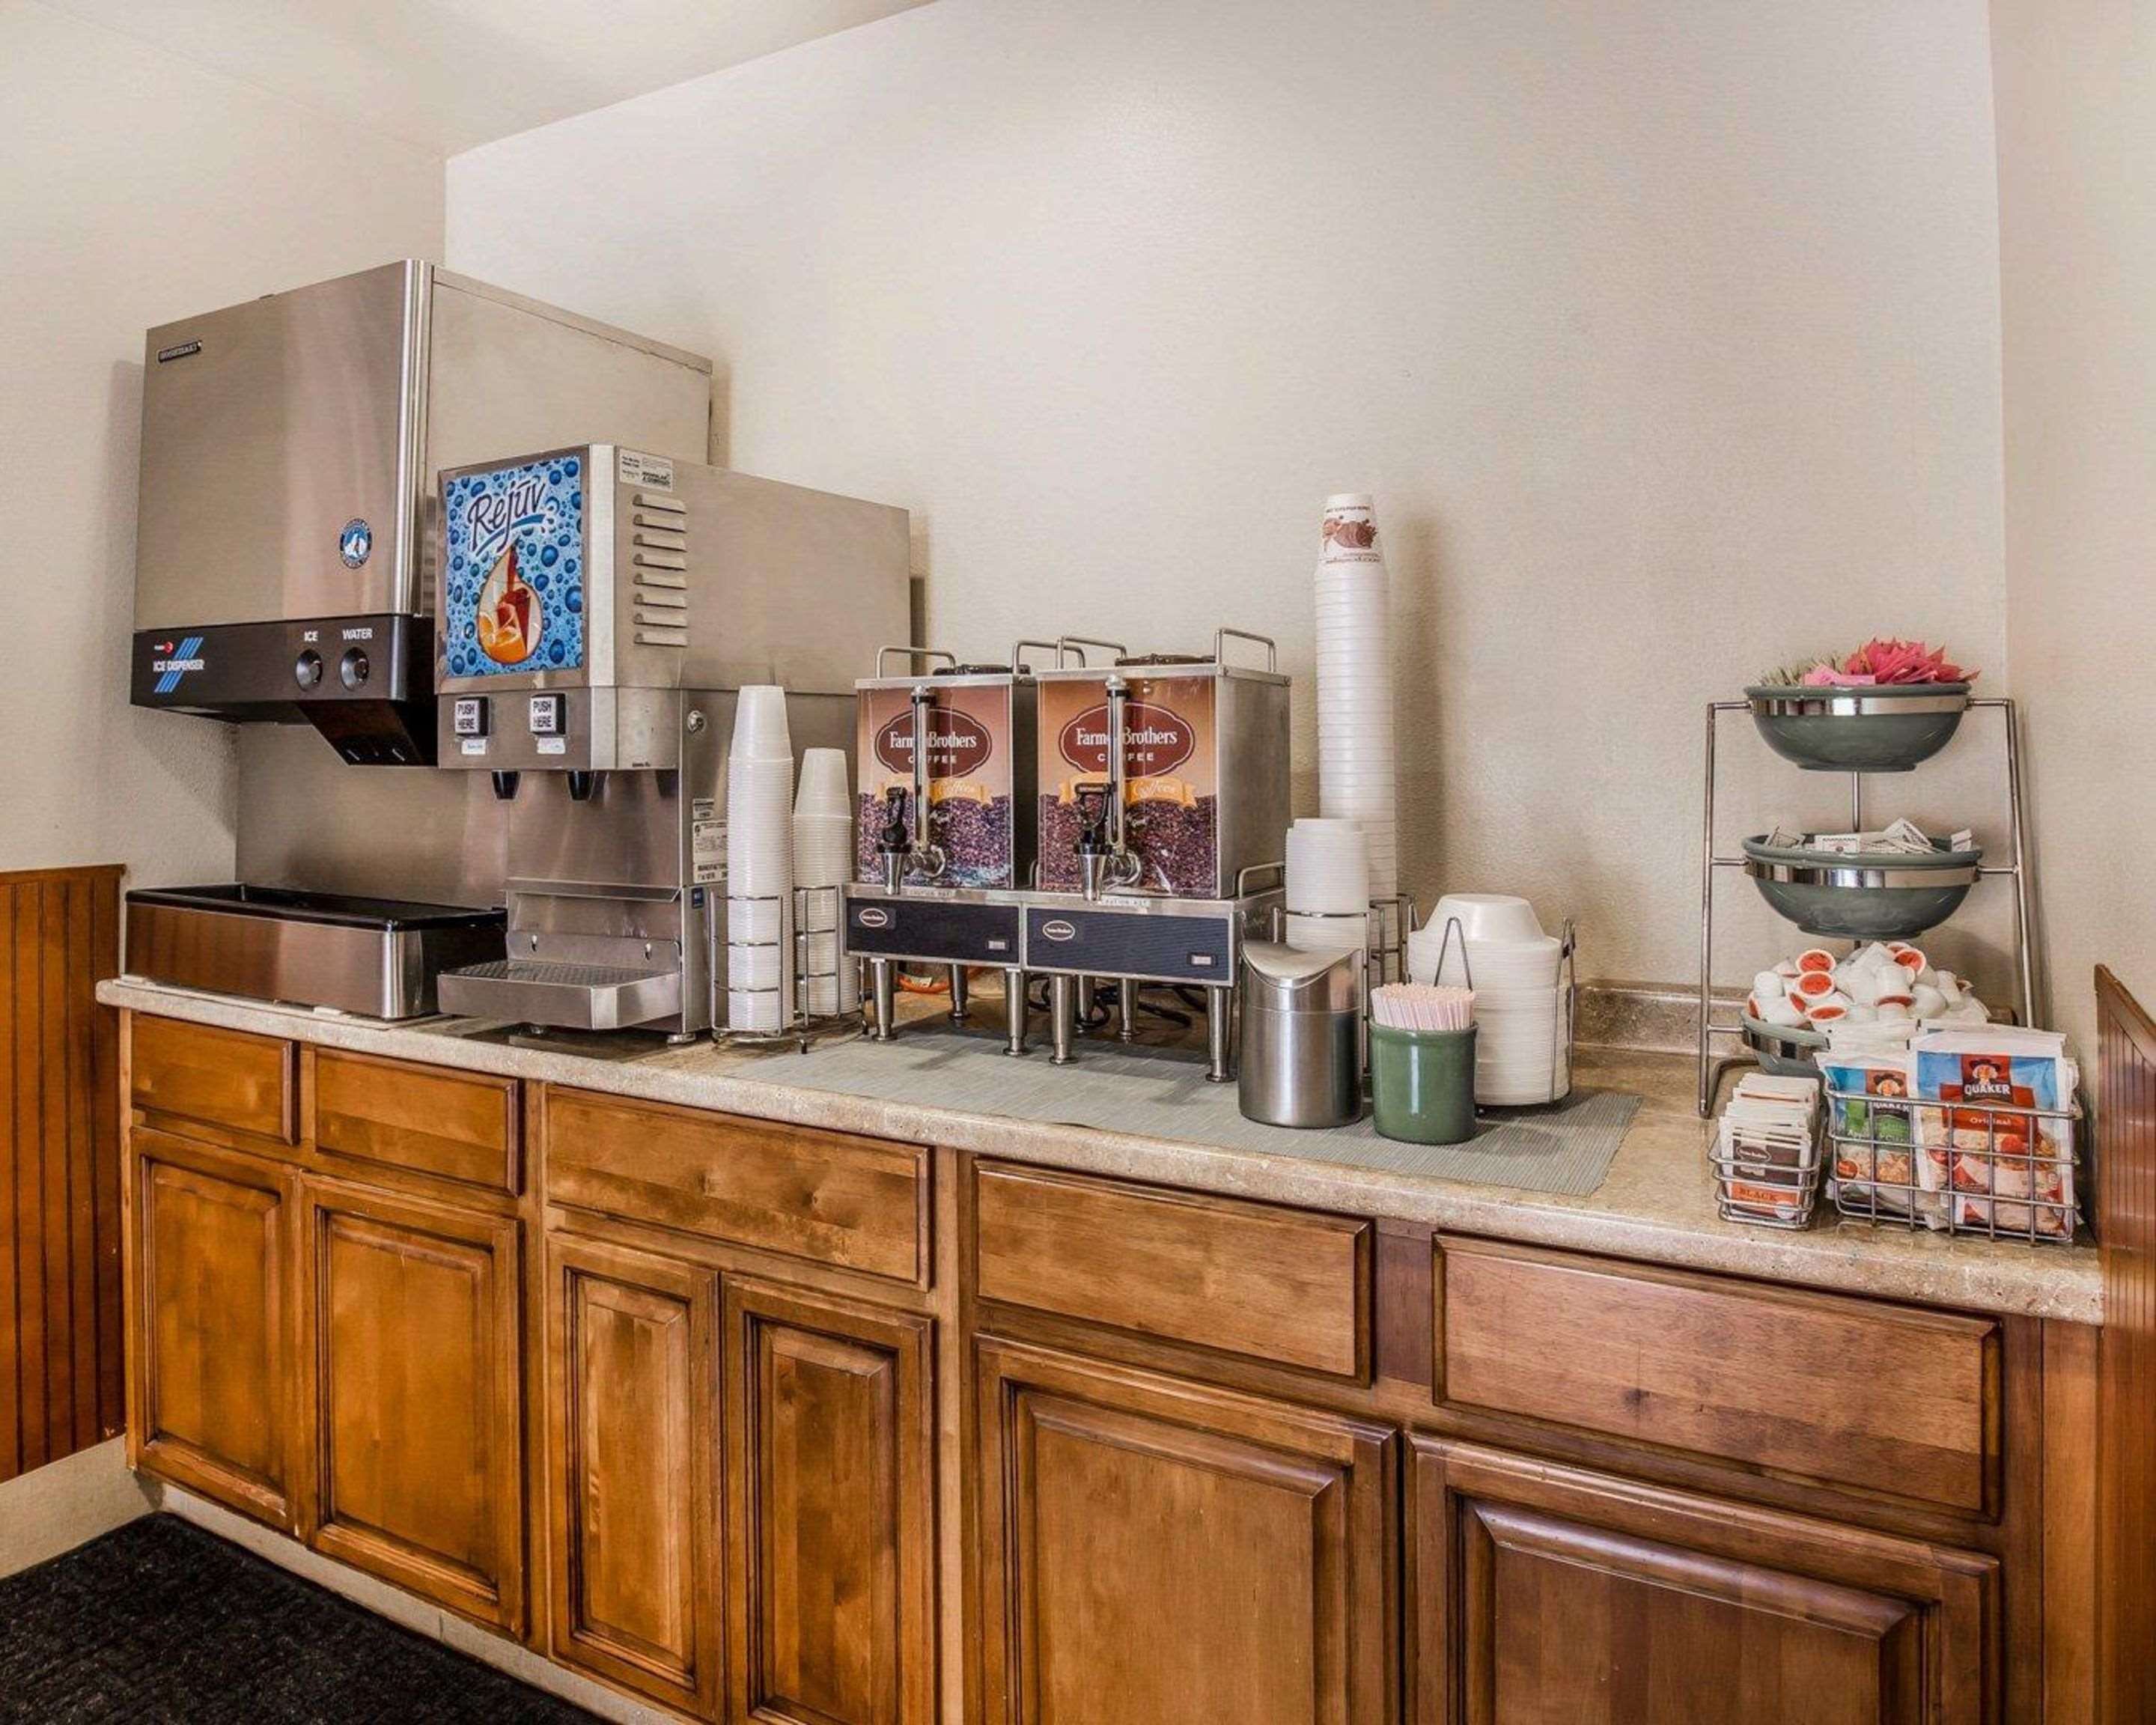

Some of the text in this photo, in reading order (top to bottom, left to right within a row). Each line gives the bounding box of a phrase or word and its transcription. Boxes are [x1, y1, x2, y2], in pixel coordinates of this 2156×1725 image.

[304, 630, 318, 642] ICE
[343, 627, 373, 640] WATER
[153, 659, 204, 672] ICE DISPENSER
[457, 704, 475, 715] PUSH
[532, 701, 552, 712] PUSH
[457, 718, 475, 729] HERE
[533, 715, 552, 728] HERE
[889, 731, 977, 749] Farm Brothers
[1076, 726, 1178, 746] Farm Brothers
[908, 754, 957, 764] CFFEE
[1097, 751, 1154, 762] CFEE
[1964, 1083, 2011, 1095] QUAKER
